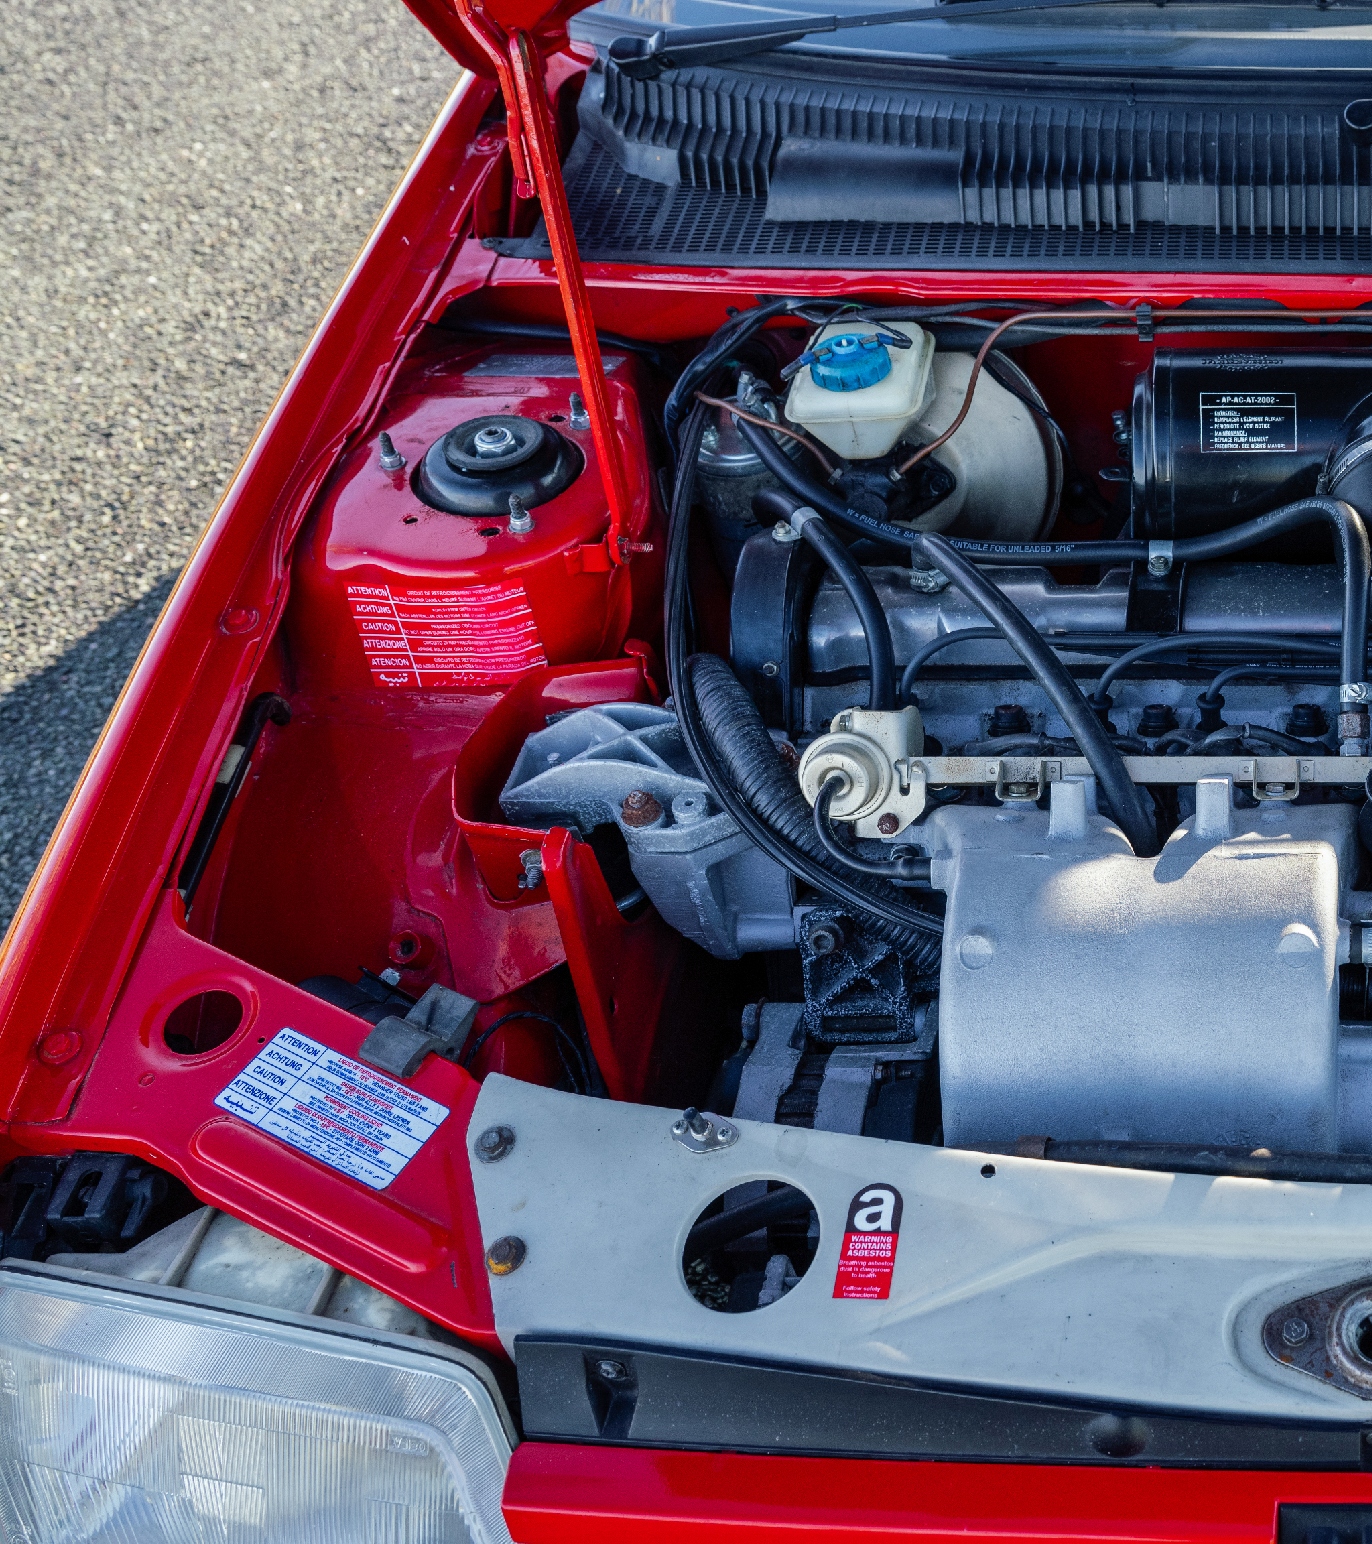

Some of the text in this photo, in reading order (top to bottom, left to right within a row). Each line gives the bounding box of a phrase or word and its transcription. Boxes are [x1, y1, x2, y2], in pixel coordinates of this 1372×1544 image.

[860, 514, 878, 528] FUEL
[880, 523, 901, 534] HOSE
[990, 544, 1007, 553] FOR
[1008, 545, 1051, 553] UNLEADED
[347, 585, 388, 597] ATTENTION
[356, 604, 391, 614] ACHTUNG
[362, 622, 396, 632] CAUTION
[363, 638, 408, 649] ATTENZIONE
[371, 657, 410, 667] ATENCION
[279, 1032, 321, 1057] ATTENTION
[265, 1049, 304, 1072] ACHTUNG
[252, 1065, 287, 1087] CAUTION
[232, 1079, 278, 1106] ATTENZIONE
[854, 1189, 895, 1231] a
[851, 1235, 892, 1243] WARNING
